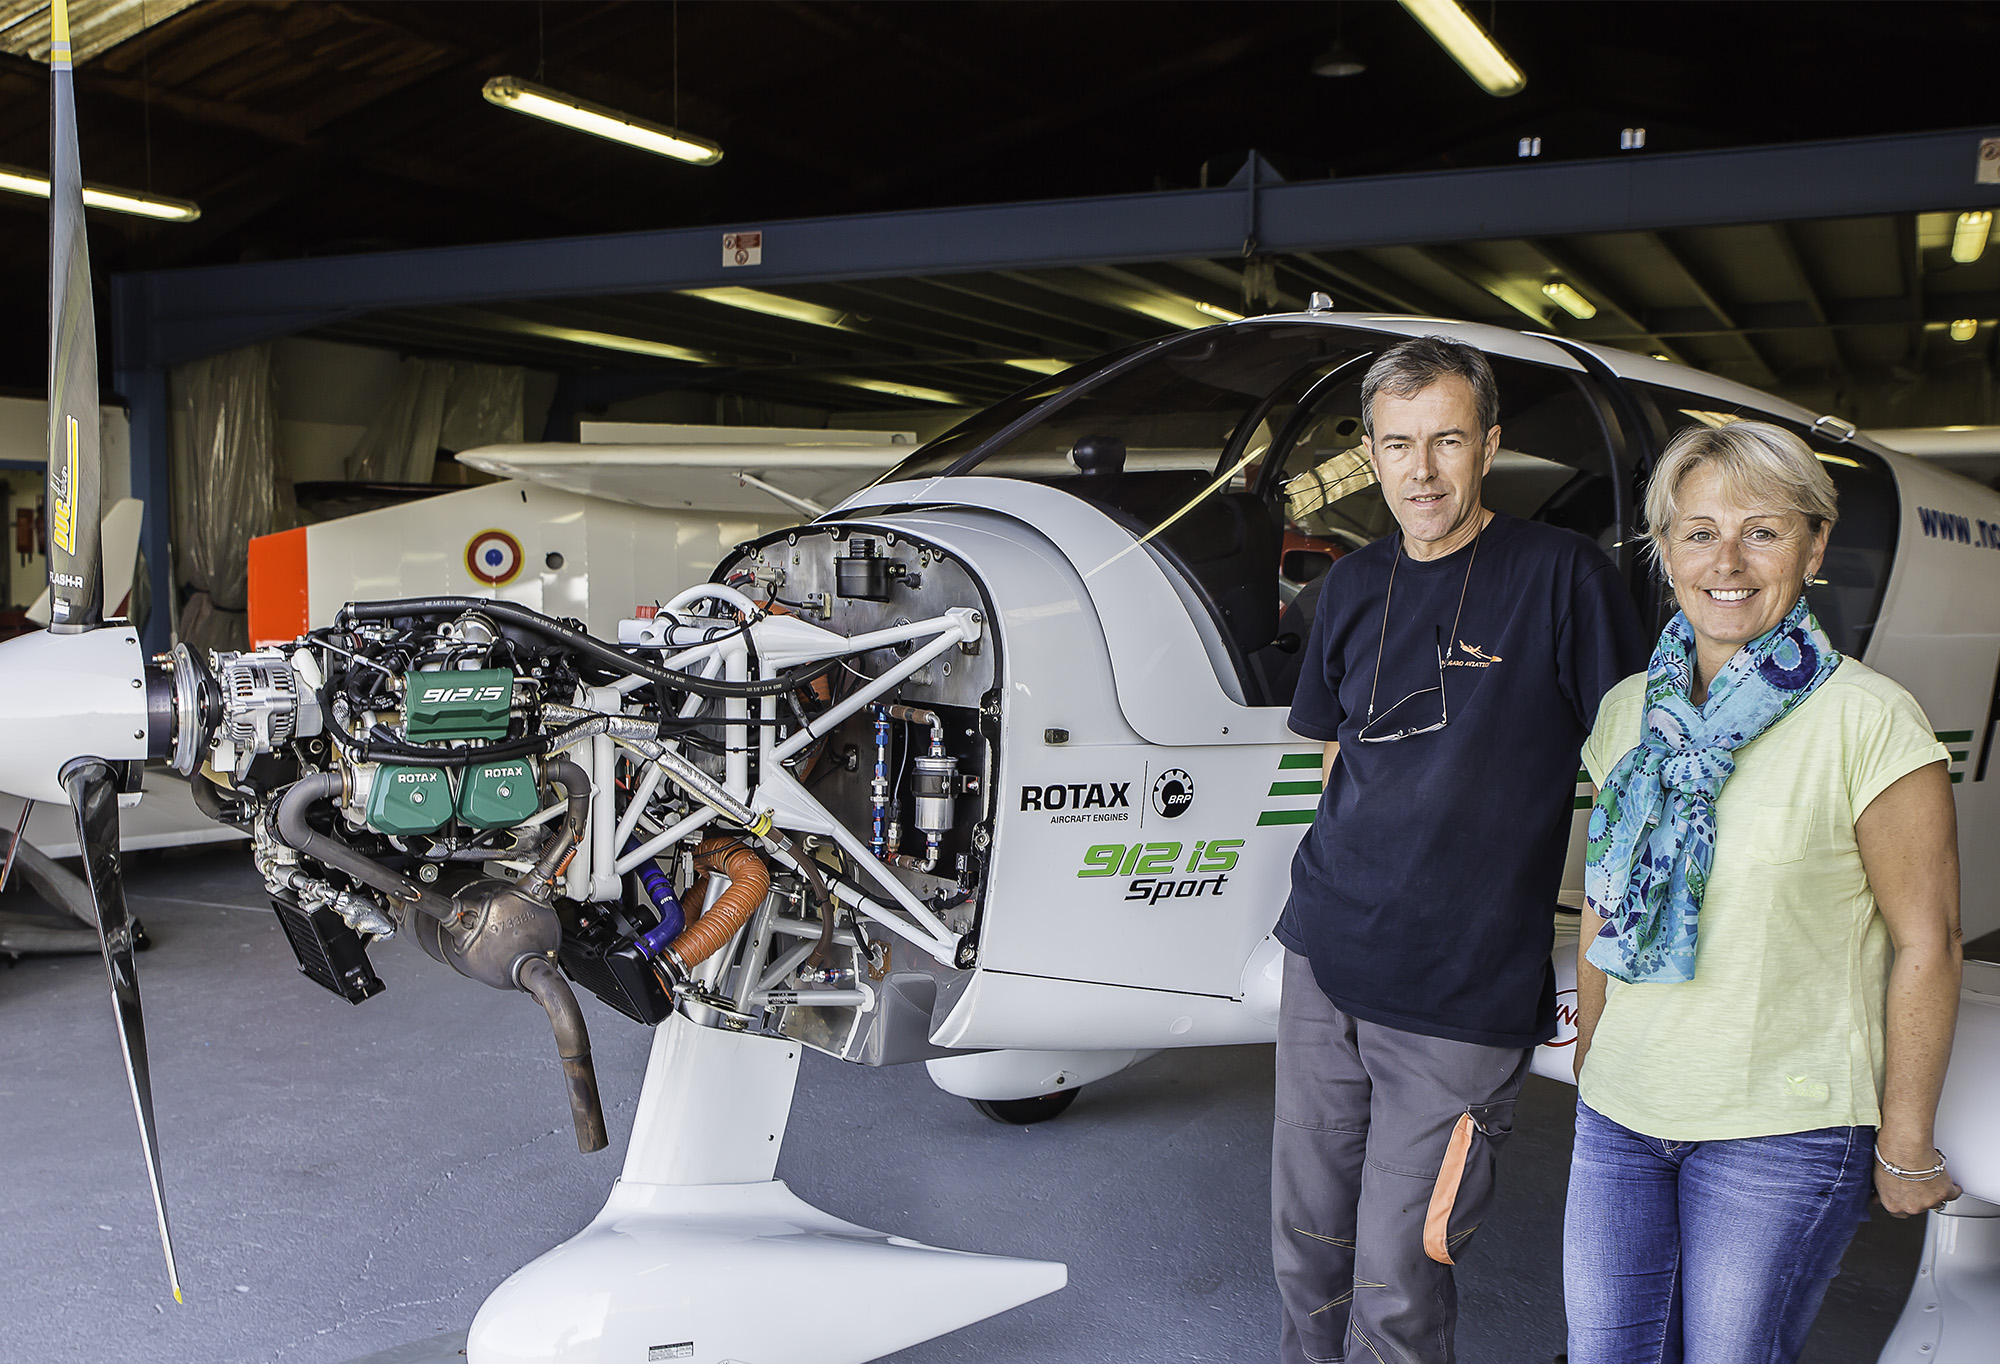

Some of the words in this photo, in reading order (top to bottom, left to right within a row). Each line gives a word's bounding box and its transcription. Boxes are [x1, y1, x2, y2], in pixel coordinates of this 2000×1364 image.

[53, 498, 71, 552] DUC
[1441, 659, 1464, 667] NGARO
[420, 687, 474, 704] 912
[397, 772, 438, 784] ROTAX
[484, 766, 523, 778] ROTAX
[1020, 782, 1131, 812] ROTAX
[1167, 794, 1192, 805] BRP
[1050, 814, 1091, 824] AIRCRAFT
[1092, 812, 1129, 822] ENGINES
[1076, 841, 1183, 878] 912
[1123, 873, 1229, 906] Sport
